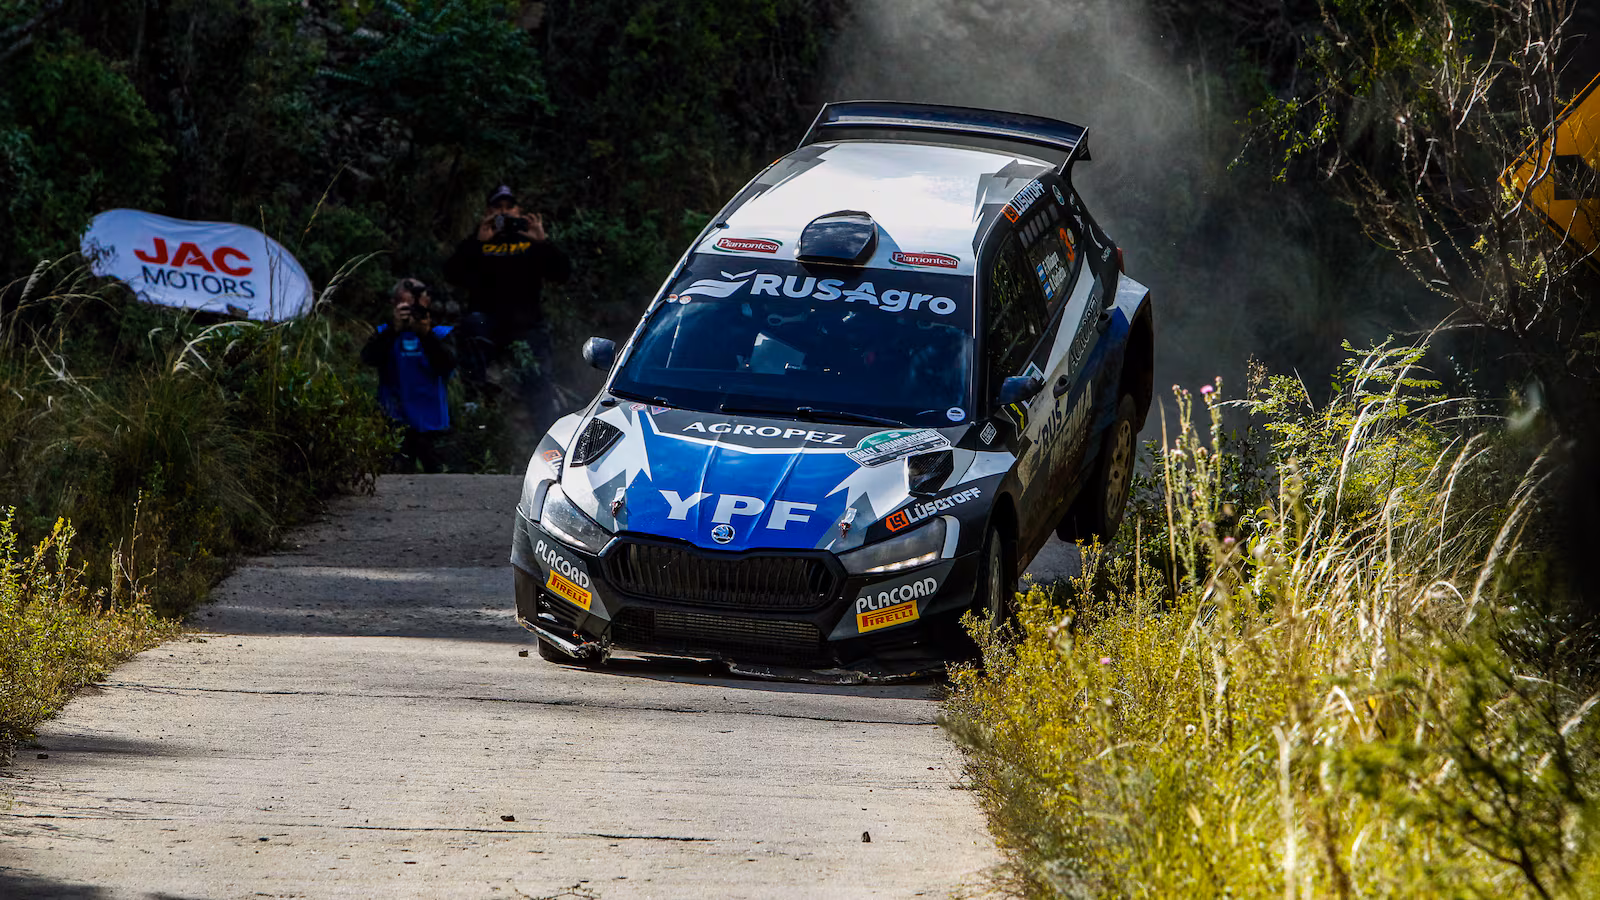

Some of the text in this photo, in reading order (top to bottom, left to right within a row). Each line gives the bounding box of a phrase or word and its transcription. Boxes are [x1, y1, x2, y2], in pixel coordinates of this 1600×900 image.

[133, 237, 253, 276] JAC
[718, 238, 778, 251] Piamontesa
[894, 252, 957, 266] Piamontesa
[141, 265, 255, 298] MOTORS
[682, 421, 847, 445] AGROPEZ
[850, 446, 877, 460] RALLY
[875, 429, 936, 451] SUDAMERICANO
[658, 489, 818, 531] YPF
[535, 539, 590, 588] PLACORD
[551, 575, 589, 605] PIRELLI
[855, 577, 938, 614] PLACORD
[861, 604, 914, 627] PIRELLI
